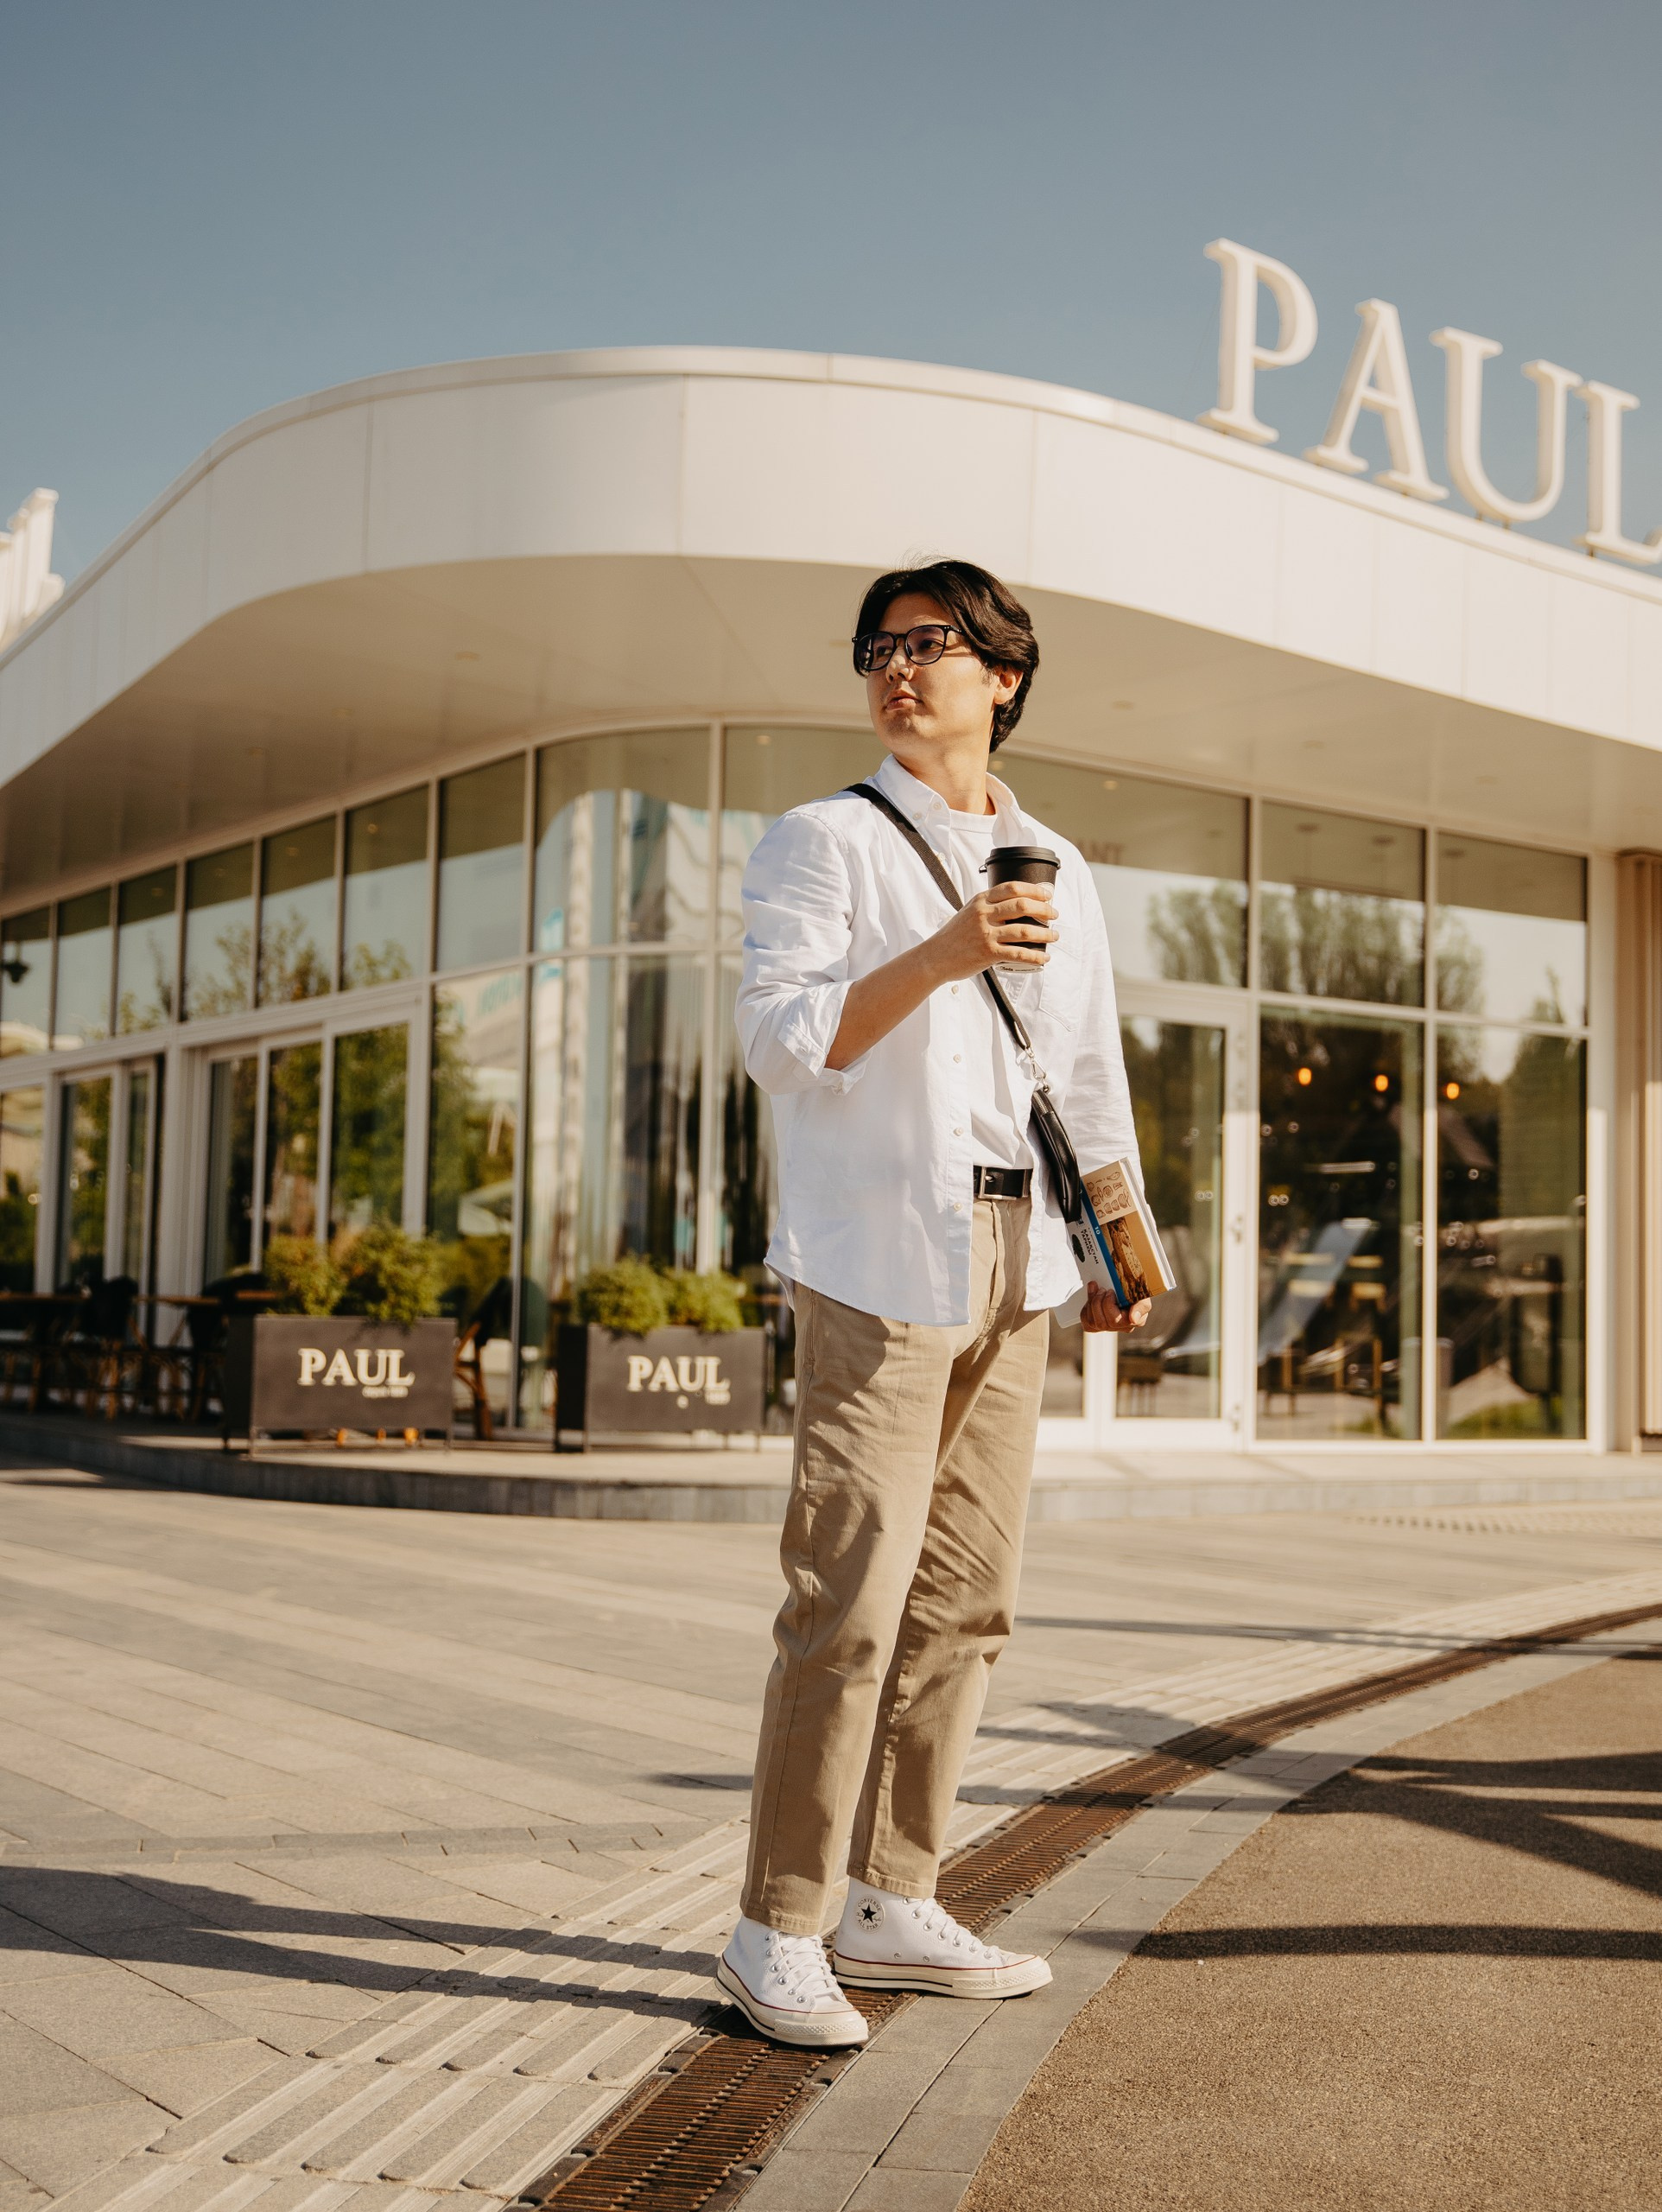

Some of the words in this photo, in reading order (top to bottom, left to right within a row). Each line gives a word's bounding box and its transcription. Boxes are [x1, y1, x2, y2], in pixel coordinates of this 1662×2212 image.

[1196, 237, 1662, 565] PAUL
[1094, 1226, 1101, 1235] 10
[297, 1348, 416, 1387] PAUL
[626, 1355, 731, 1393] PAUL
[857, 1897, 880, 1911] CONVERSE
